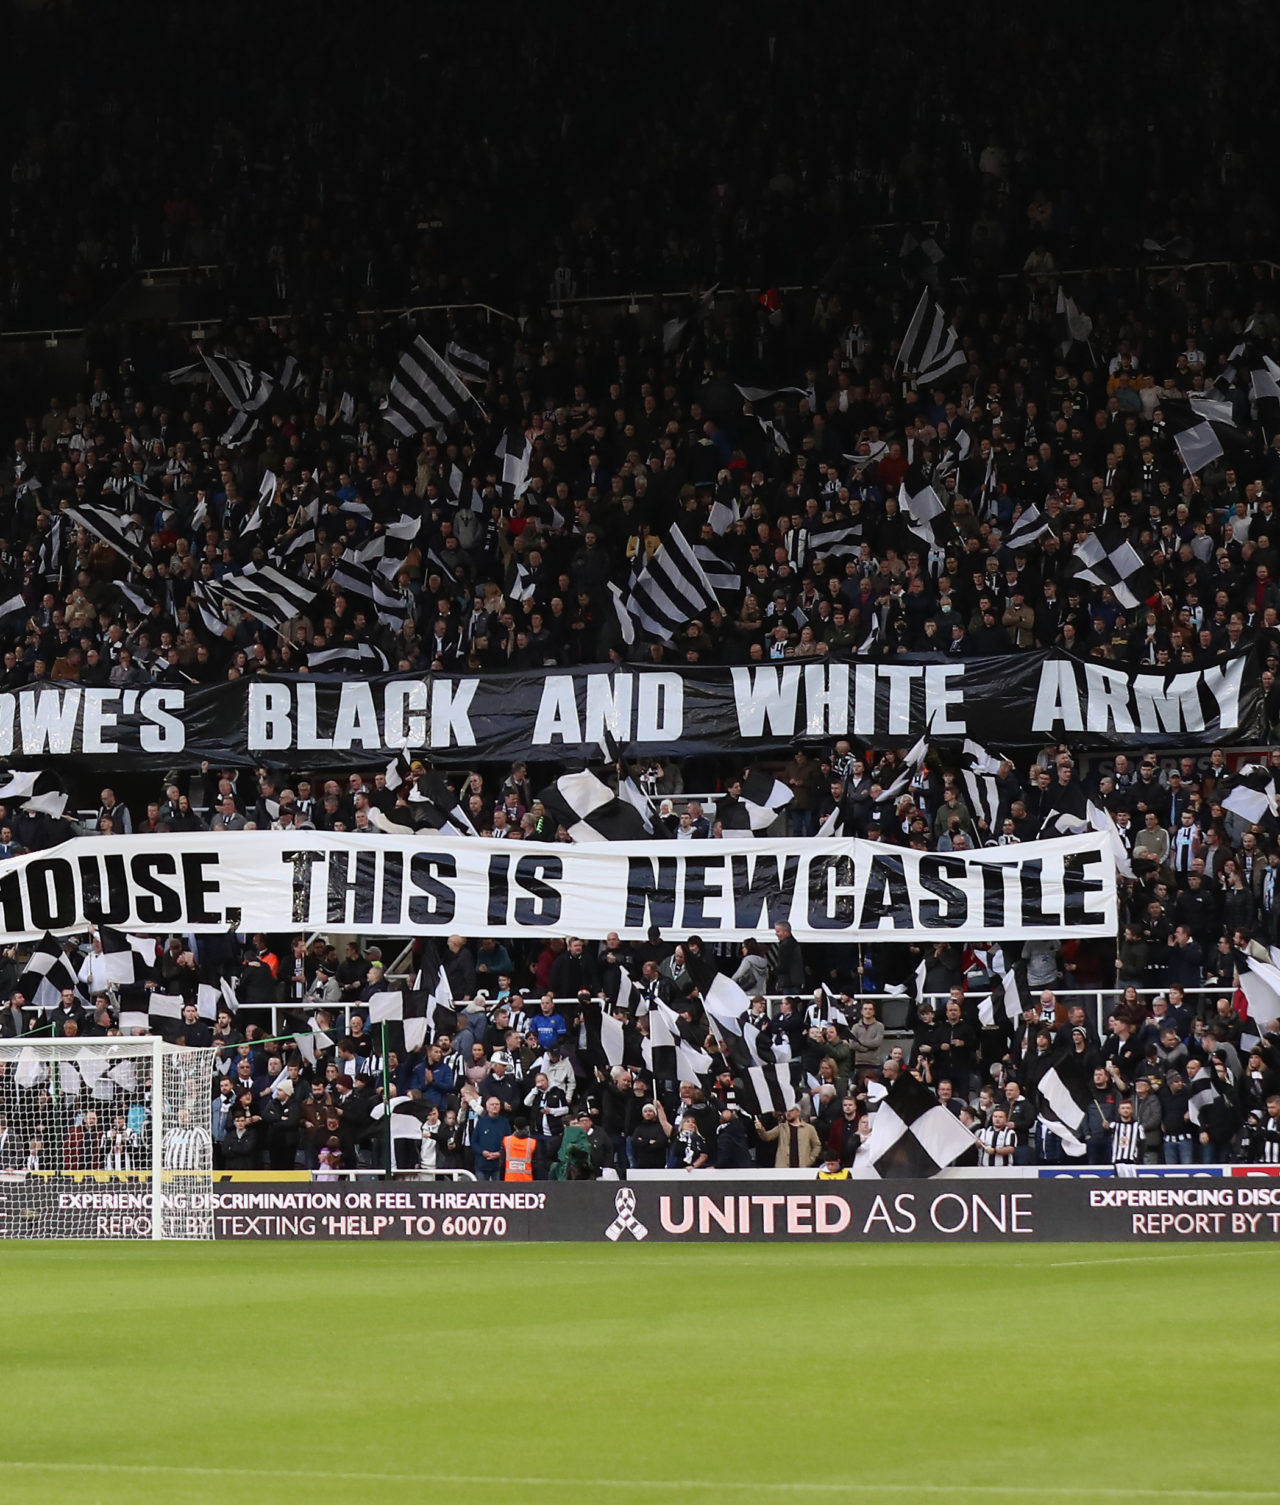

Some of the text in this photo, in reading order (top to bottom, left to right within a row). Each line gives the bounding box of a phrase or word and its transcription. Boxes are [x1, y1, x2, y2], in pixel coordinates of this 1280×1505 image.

[247, 679, 480, 750] BLACK
[532, 672, 683, 744] AND
[730, 663, 966, 737] WHITE
[1032, 655, 1247, 733] ARMY
[282, 850, 457, 927] THIS
[487, 853, 563, 926] IS
[624, 850, 1106, 930] NEWCASTLE
[191, 1192, 340, 1209] DISCRIMINATION
[345, 1193, 371, 1209] OR
[375, 1193, 416, 1209] FEEL
[420, 1193, 546, 1210] THREATENED?
[1090, 1190, 1233, 1206] EXPERIENCING
[659, 1193, 1033, 1234] UNITED AS ONE
[1132, 1213, 1226, 1234] REPORT
[1232, 1213, 1263, 1233] BY
[217, 1216, 317, 1235] TEXTING
[400, 1217, 435, 1235] TO
[441, 1217, 507, 1235] 60070
